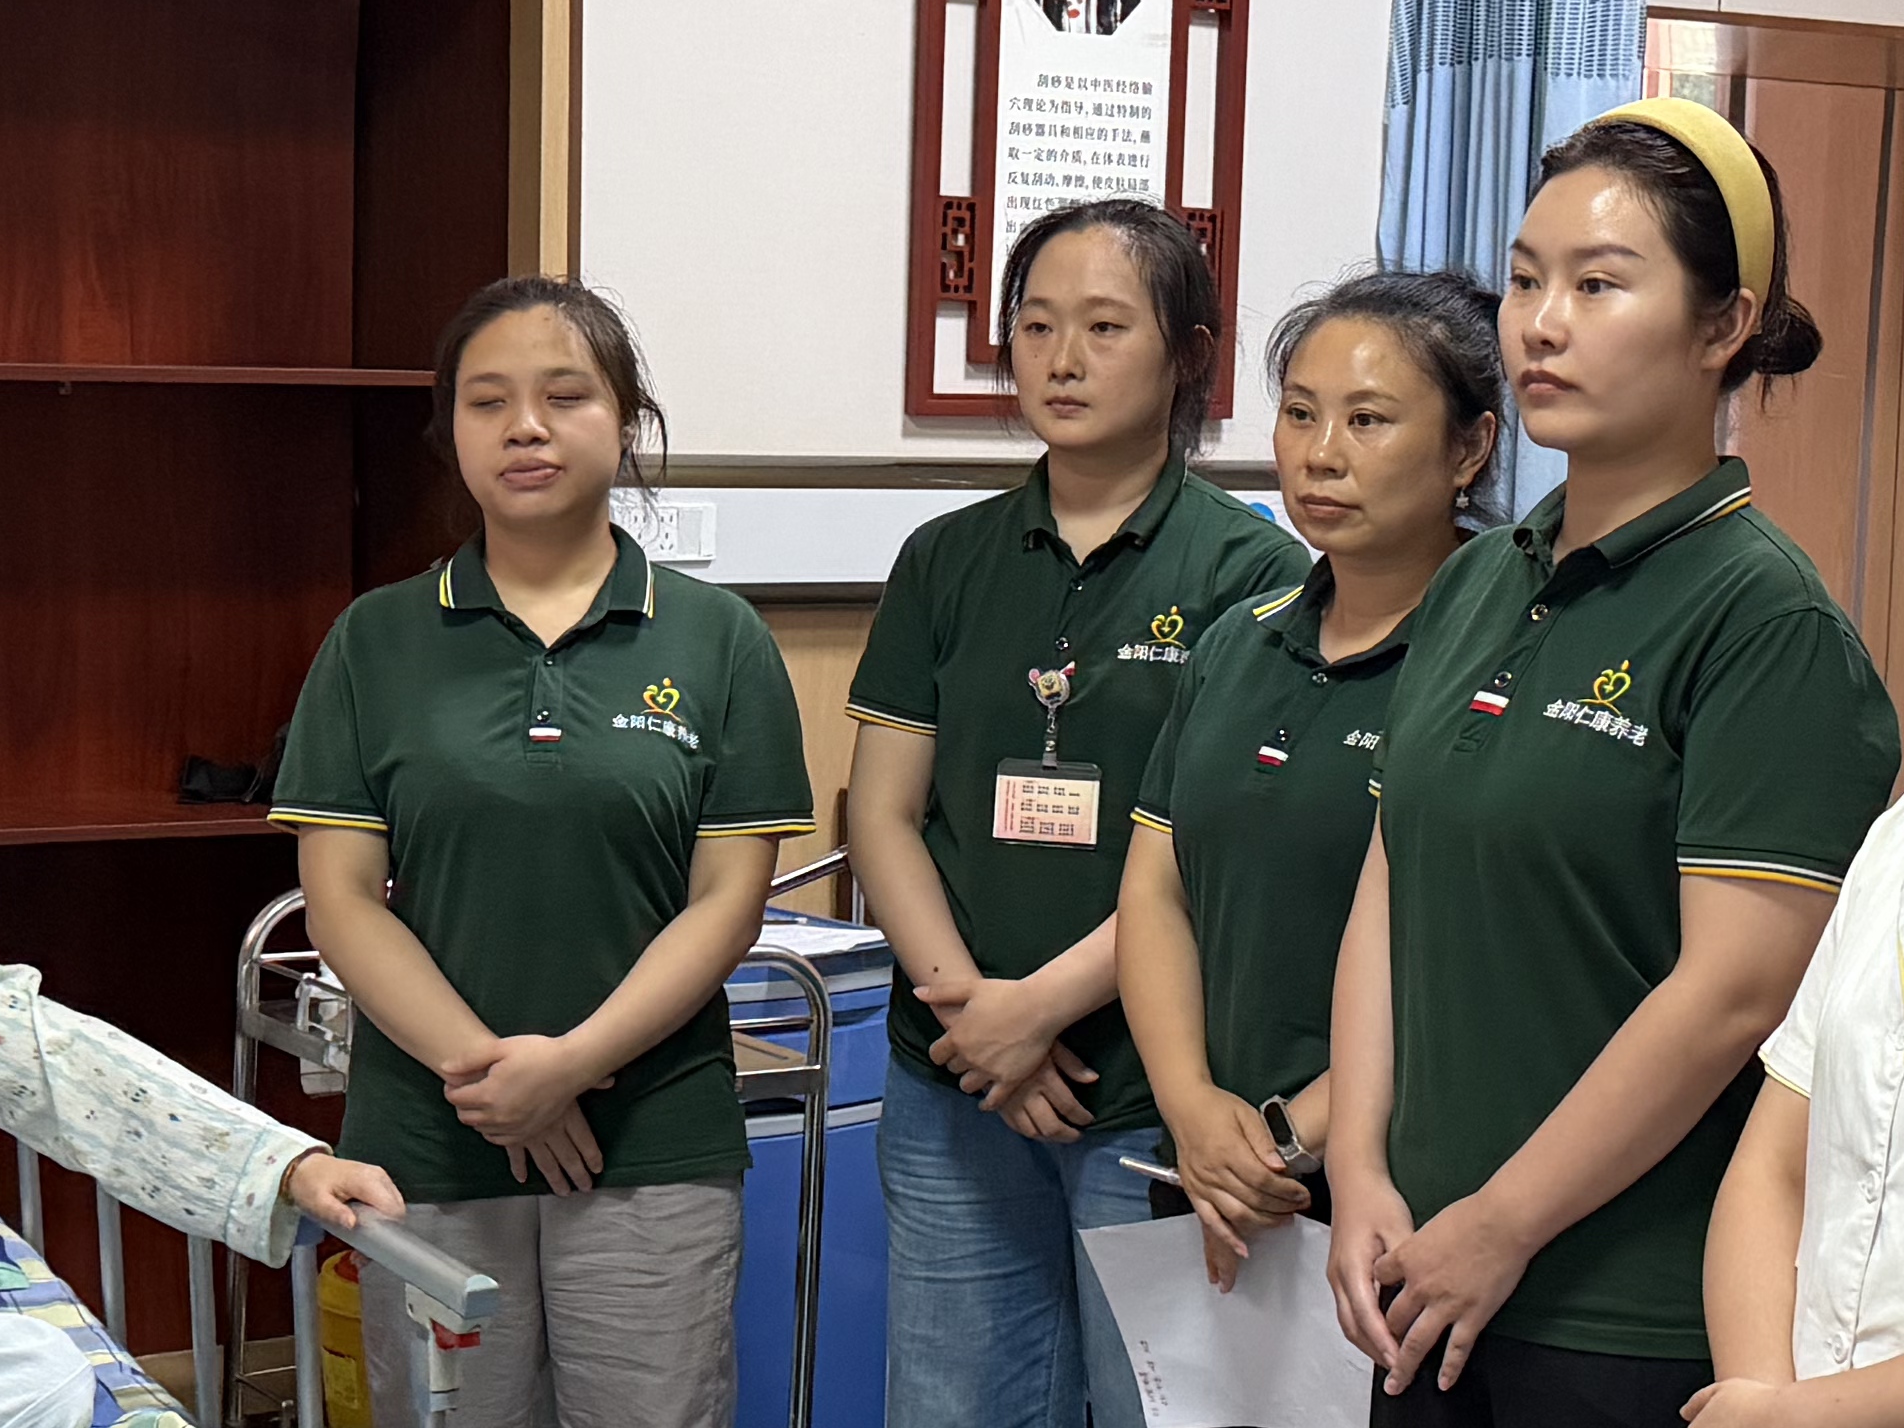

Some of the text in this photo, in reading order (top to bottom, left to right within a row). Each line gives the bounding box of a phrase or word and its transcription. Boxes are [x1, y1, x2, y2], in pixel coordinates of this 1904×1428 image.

[1542, 699, 1648, 747] 金阳仁康养老
